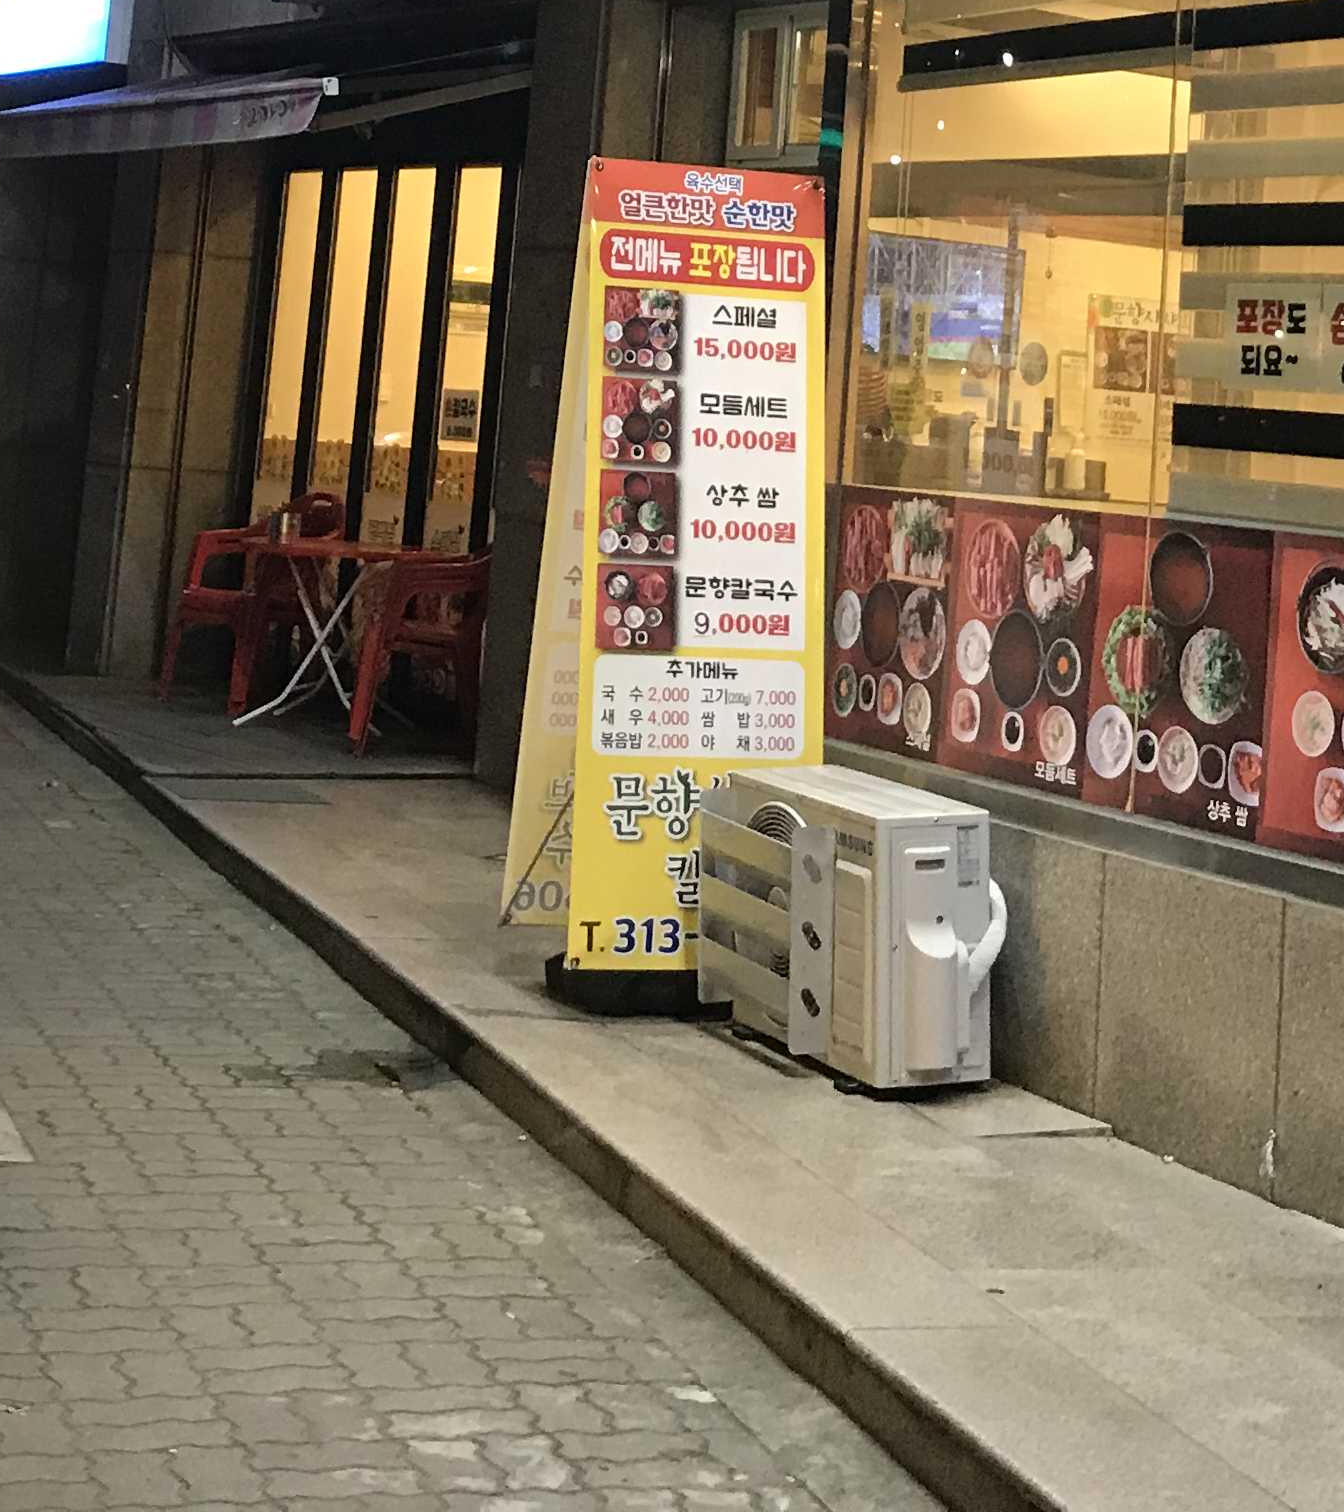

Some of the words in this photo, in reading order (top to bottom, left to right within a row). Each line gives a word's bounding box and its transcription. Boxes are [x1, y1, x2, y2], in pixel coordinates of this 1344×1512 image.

[685, 171, 743, 194] 육수선택
[618, 190, 716, 225] 얼큰한맛
[723, 197, 797, 232] 순한맛
[610, 235, 683, 274] 전메뉴
[689, 242, 807, 286] 포장됩니다
[712, 304, 778, 329] 스페셜
[1236, 299, 1307, 335] 포장도
[693, 336, 797, 364] 15,000원
[699, 393, 789, 420] 모듬세트
[691, 427, 797, 453] 10,000원
[706, 483, 750, 508] 상추
[756, 486, 780, 509] 쌈
[690, 519, 796, 545] 10,000원
[684, 575, 799, 603] 문향칼국수
[693, 612, 791, 637] 9,000원
[666, 659, 739, 680] 추가메뉴
[647, 686, 690, 704] 2,000
[755, 689, 797, 707] 7,000
[647, 710, 690, 727] 4,000
[755, 713, 796, 730] 3,000
[600, 731, 642, 750] 볶음밥
[647, 733, 690, 750] 2,000
[755, 735, 795, 753] 3,000
[1034, 760, 1077, 785] 모듬세트
[1207, 799, 1231, 823] 상추
[1235, 805, 1249, 827] 쌈
[579, 921, 605, 952] T.
